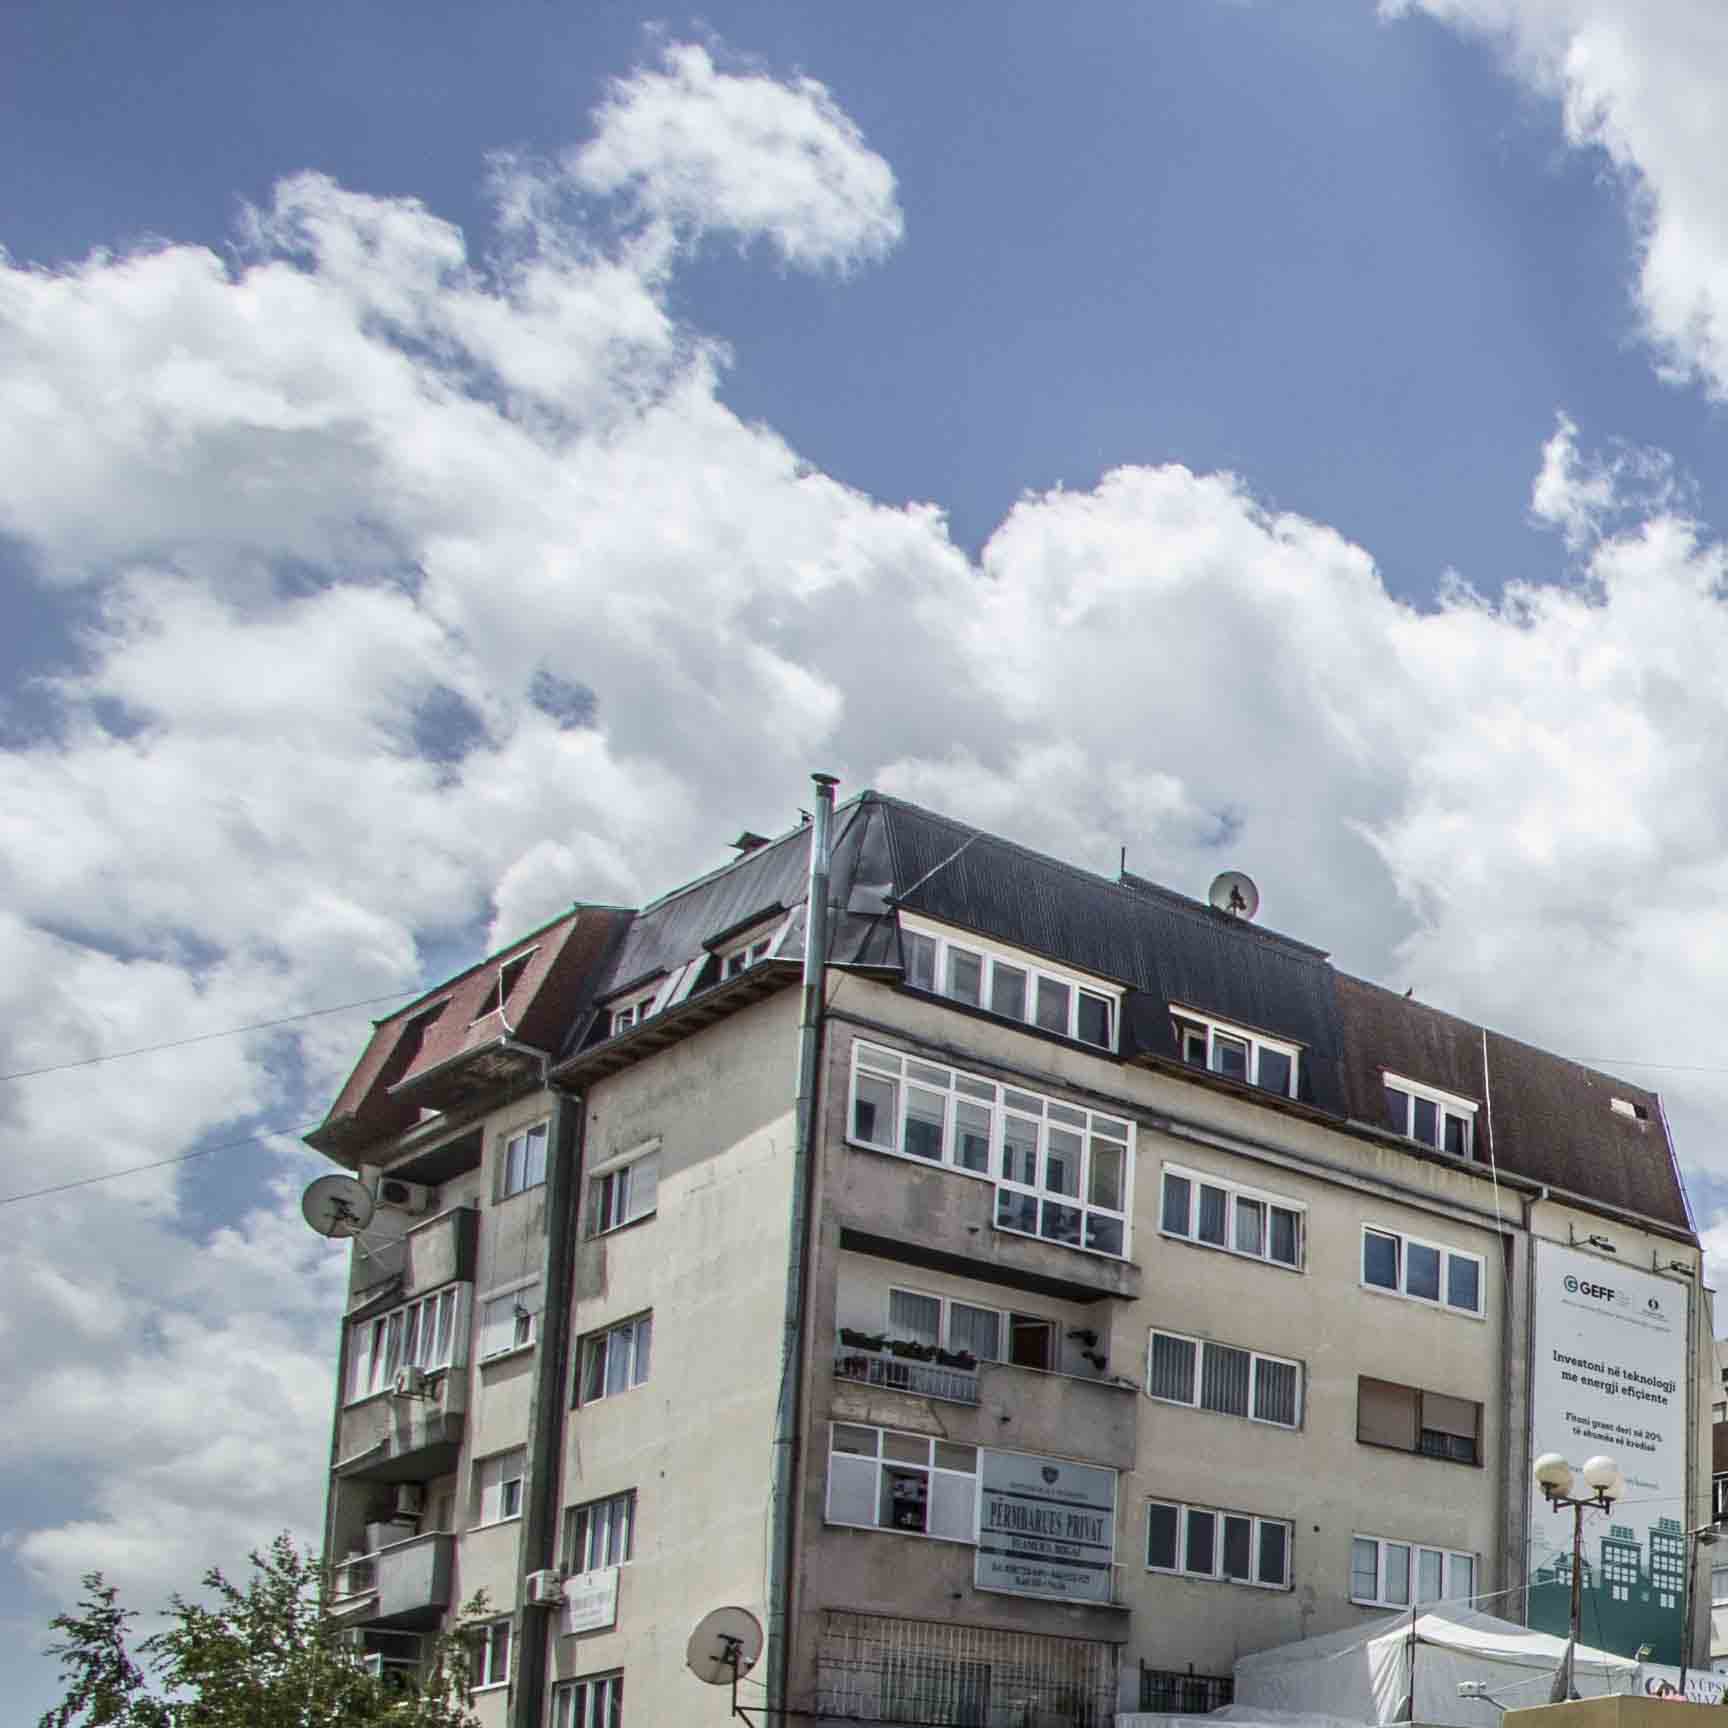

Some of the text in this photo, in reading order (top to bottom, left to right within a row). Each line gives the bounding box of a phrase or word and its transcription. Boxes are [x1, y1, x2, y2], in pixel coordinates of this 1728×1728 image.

[1580, 1281, 1615, 1301] GEFF
[1552, 1350, 1676, 1394] Investoni në teknologji
[1561, 1370, 1578, 1382] me
[1581, 1376, 1619, 1395] energji
